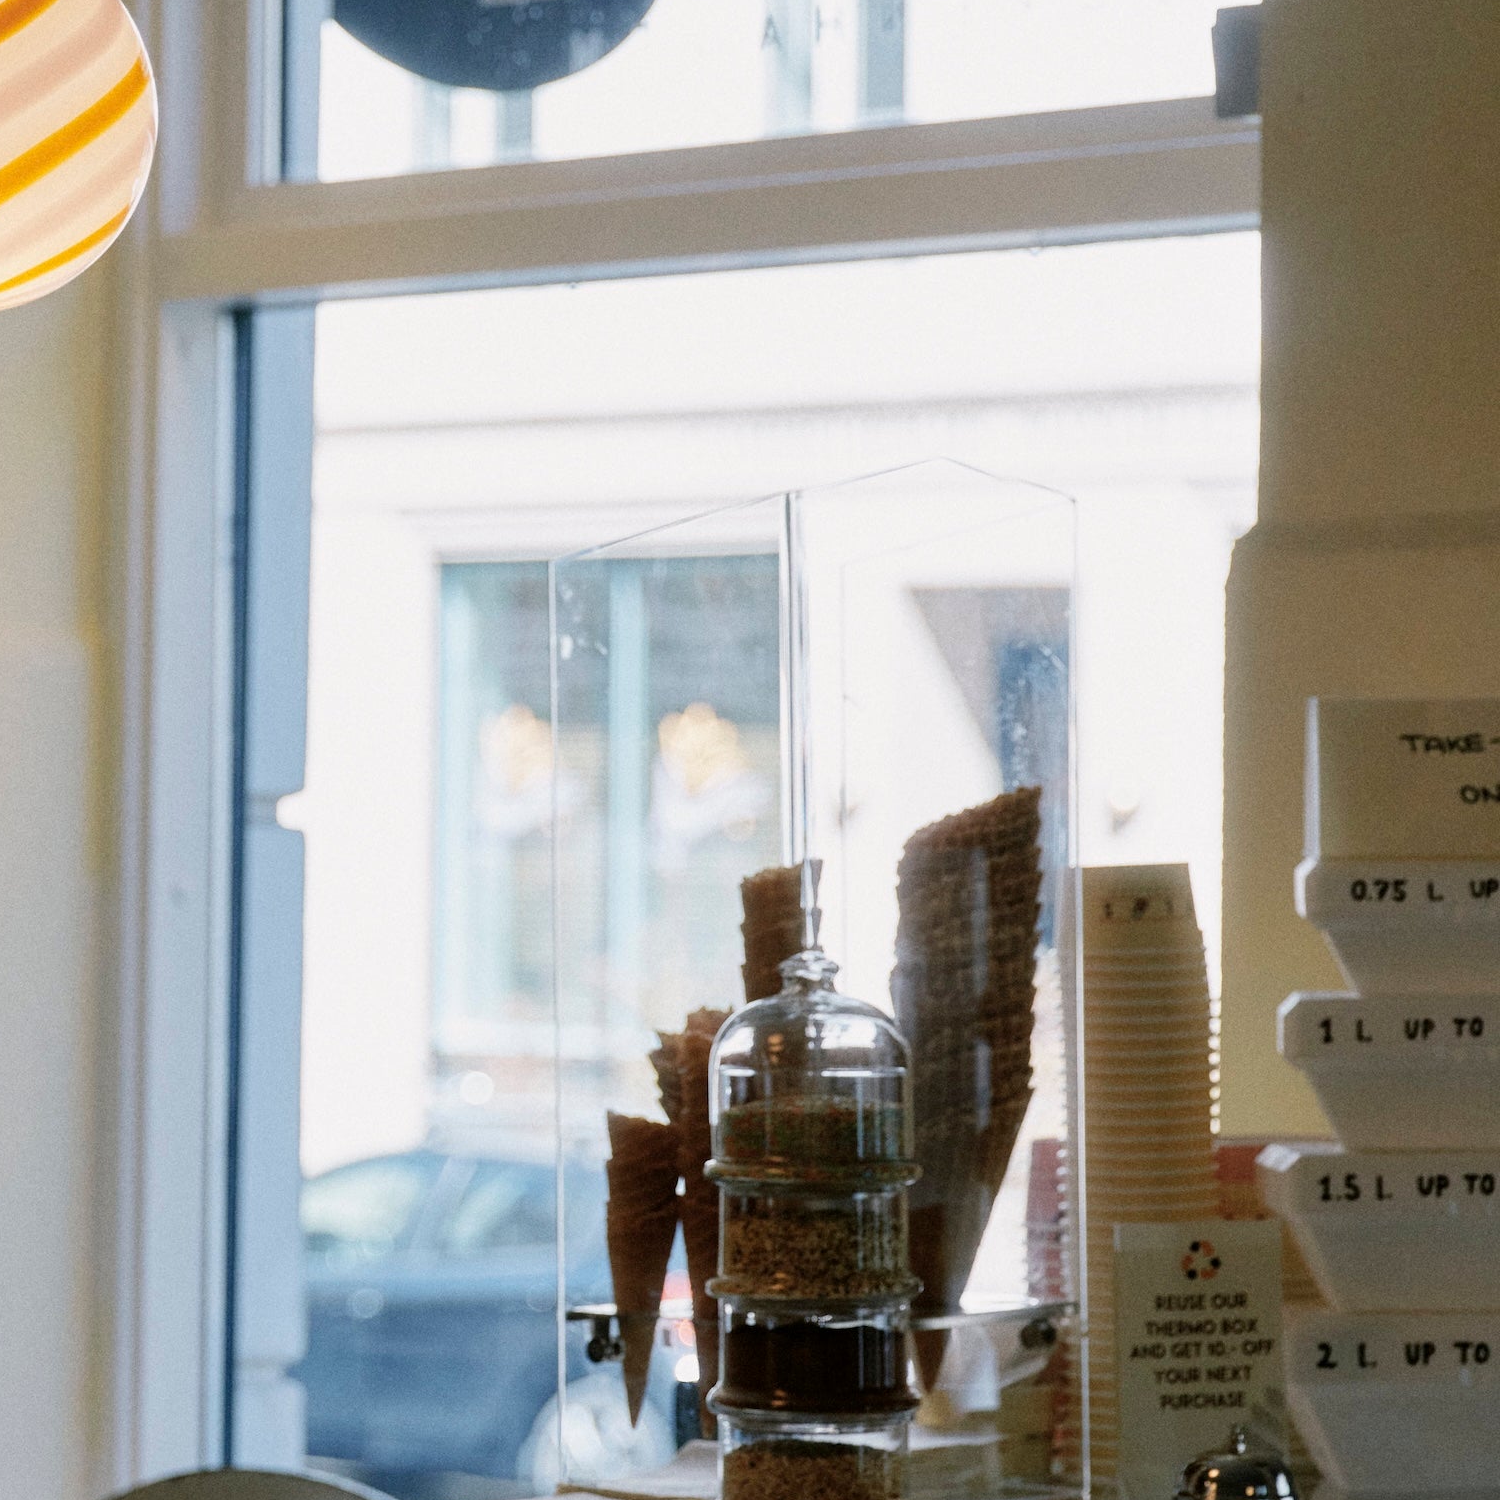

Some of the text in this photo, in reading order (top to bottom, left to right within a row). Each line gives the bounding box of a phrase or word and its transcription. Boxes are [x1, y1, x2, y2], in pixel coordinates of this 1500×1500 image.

[1350, 879, 1407, 902] 0.75
[1470, 878, 1500, 899] UP
[1318, 1018, 1334, 1043] 1
[1405, 1017, 1434, 1040] UP
[1454, 1016, 1485, 1038] TO
[1319, 1175, 1361, 1202] 1.5
[1417, 1175, 1449, 1197] UP
[1464, 1174, 1495, 1196] TO
[1155, 1292, 1248, 1312] REUSE OUR
[1145, 1318, 1259, 1338] THERMO BOX
[1130, 1343, 1167, 1360] AND
[1171, 1342, 1203, 1359] GET
[1241, 1339, 1276, 1356] OFF
[1316, 1343, 1338, 1370] 2
[1404, 1342, 1436, 1366] UP
[1453, 1342, 1490, 1364] TO
[1153, 1365, 1253, 1385] YOUR NEXT
[1159, 1391, 1245, 1411] PURCHASE
